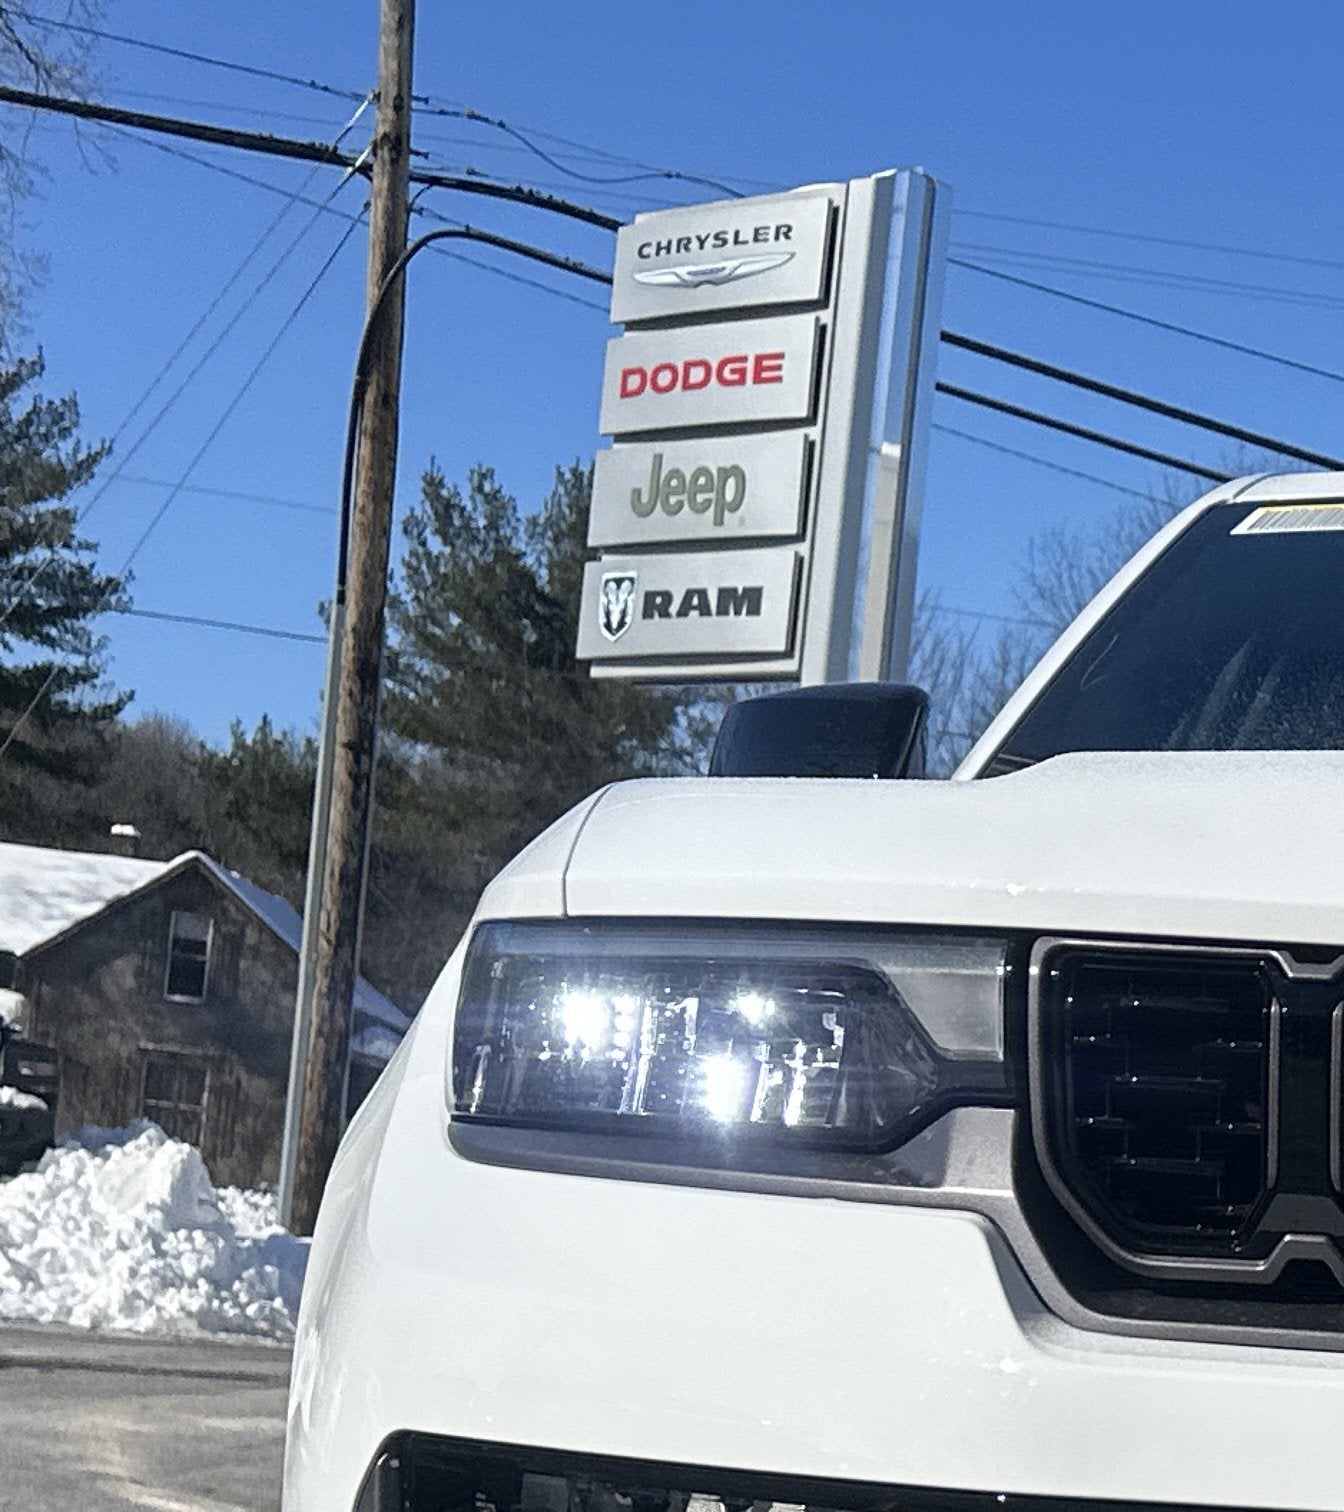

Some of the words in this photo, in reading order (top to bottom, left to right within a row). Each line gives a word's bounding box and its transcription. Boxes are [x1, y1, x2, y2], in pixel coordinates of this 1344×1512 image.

[636, 223, 794, 260] CHRYSLER
[619, 351, 786, 398] DODGE
[630, 453, 746, 526] Jeep
[641, 584, 764, 620] RAM
